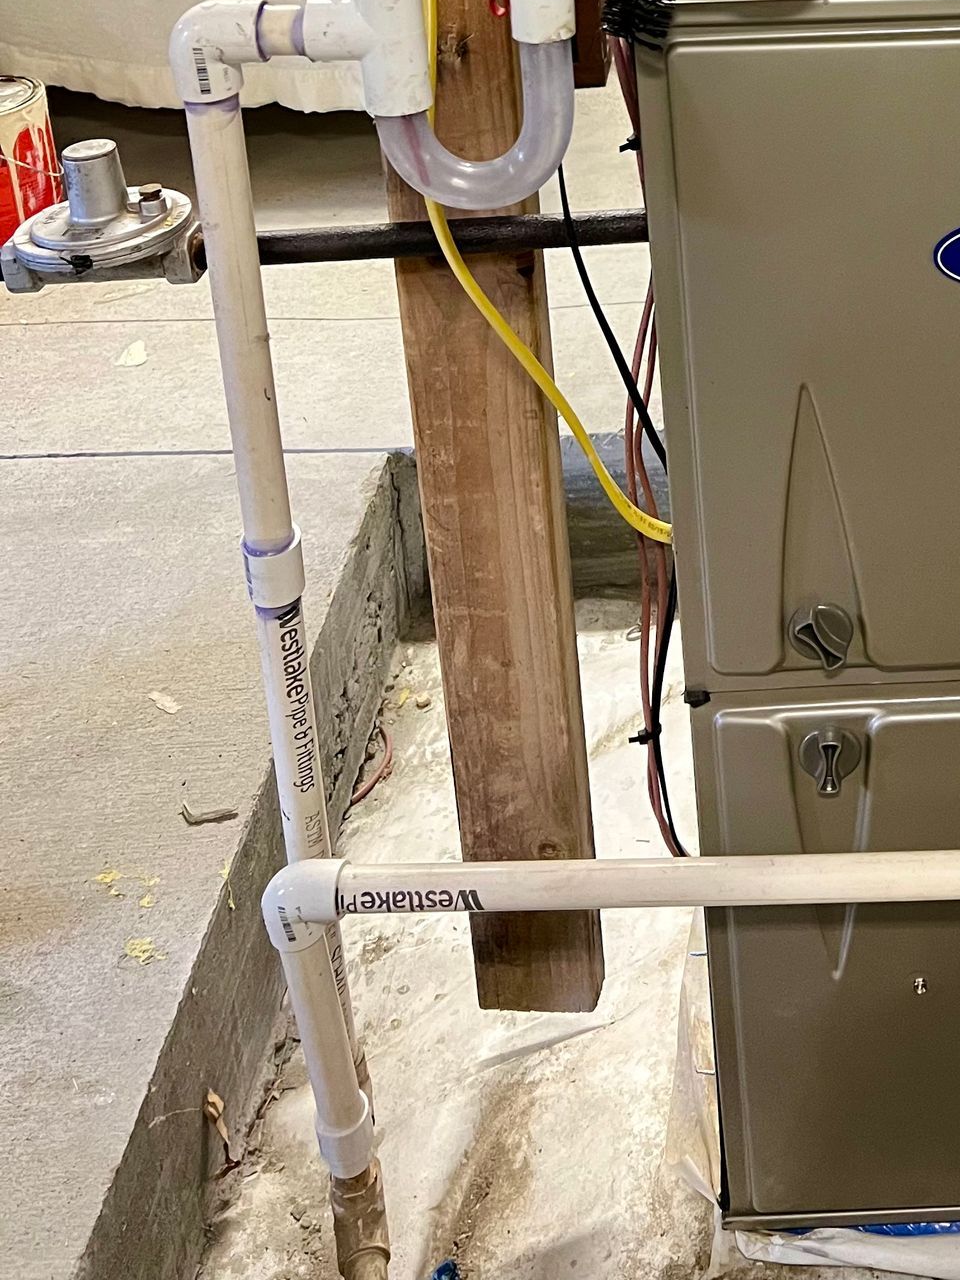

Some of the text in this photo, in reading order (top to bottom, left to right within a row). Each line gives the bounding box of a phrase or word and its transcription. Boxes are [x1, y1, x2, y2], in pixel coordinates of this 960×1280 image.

[276, 600, 306, 697] Westlake
[286, 691, 310, 730] Pipe
[294, 738, 316, 793] Fittings
[305, 812, 324, 850] ASTM
[360, 890, 484, 913] Westlake
